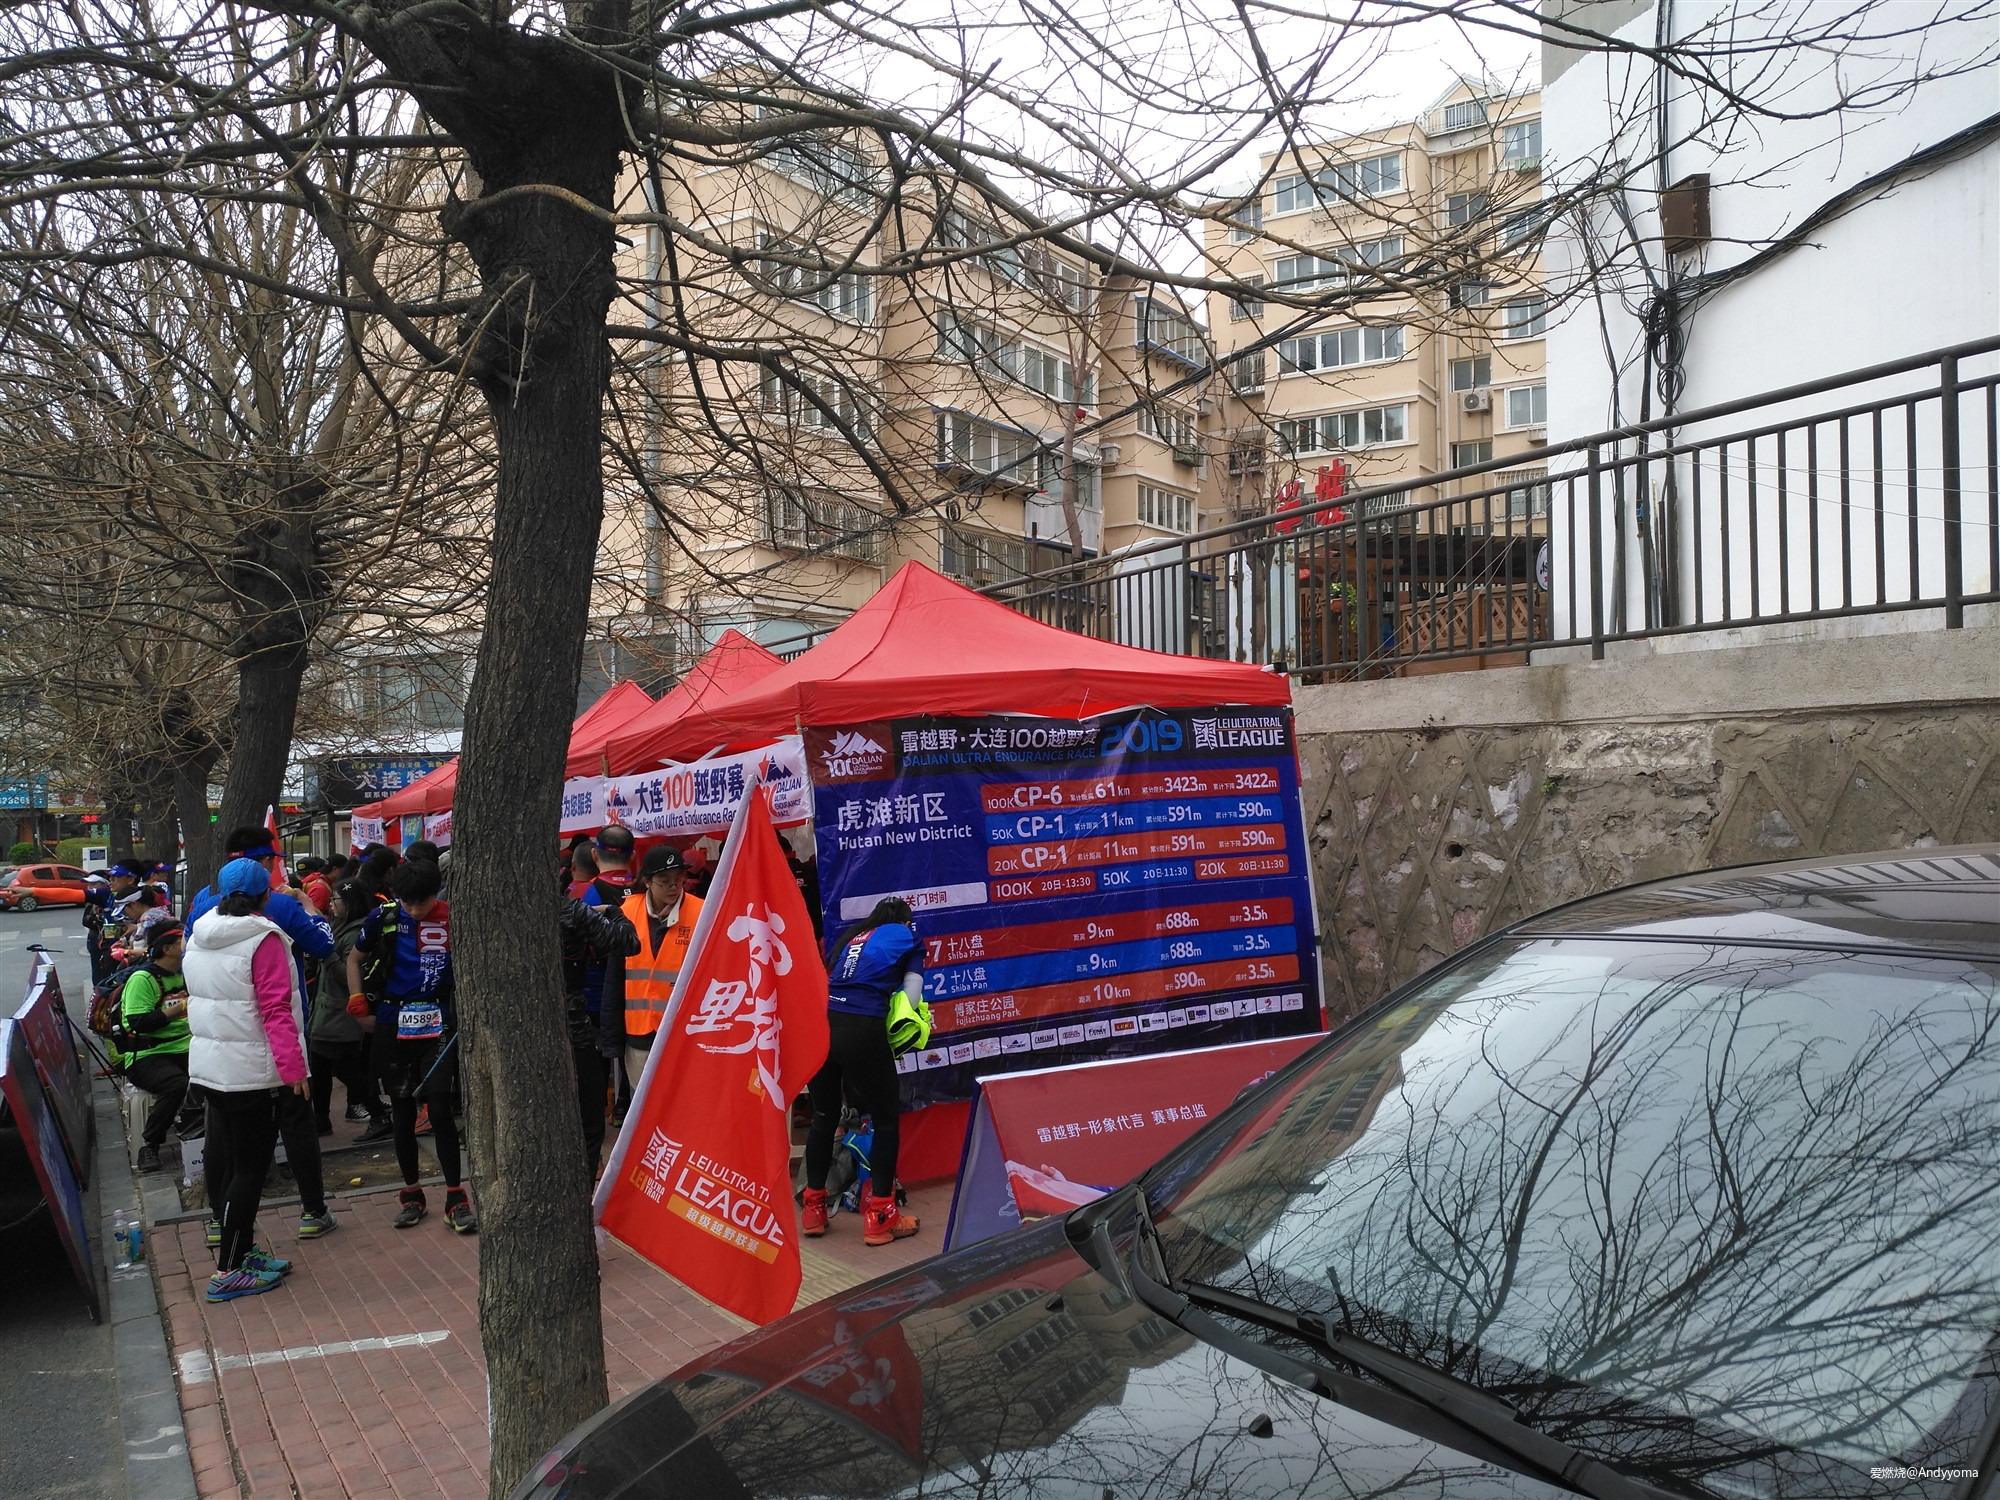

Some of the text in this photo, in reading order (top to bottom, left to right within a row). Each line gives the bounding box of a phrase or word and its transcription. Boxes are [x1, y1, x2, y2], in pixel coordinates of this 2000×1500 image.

[1101, 719, 1183, 757] 2019
[1219, 729, 1285, 747] LEAGUE
[852, 755, 883, 764] DALIAN
[902, 748, 1096, 767] DALIAN ULTRA ENDURANCE RACE
[634, 763, 745, 815] 大连100越野赛
[776, 777, 802, 793] DALIAN
[560, 791, 592, 818] 为您服务
[988, 797, 1015, 809] 100K
[1013, 784, 1063, 807] CP-6
[666, 812, 684, 828] Ultra
[684, 808, 721, 825] Endurance
[837, 792, 948, 832] 虎滩新区
[838, 824, 972, 850] Hutan New District
[992, 828, 1013, 840] 50K
[1016, 814, 1064, 838] CP-1
[994, 859, 1018, 872] 20K
[1021, 844, 1067, 869] CP-1
[1200, 862, 1226, 876] 20K
[996, 880, 1033, 898] 100K
[1103, 870, 1131, 886] 50K
[947, 934, 984, 951] 十八盘
[1242, 905, 1268, 922] 3.5h
[948, 949, 985, 961] Shiba Pan
[951, 967, 987, 984] 十八盘
[1244, 934, 1270, 950] 3.5h
[1247, 963, 1275, 980] 3.5h
[951, 981, 988, 993] Shiba Pan
[402, 1013, 432, 1024] M589
[956, 1008, 1021, 1026] Fujiazhuang Park
[1036, 1103, 1208, 1143] 雷越野-形象代言 赛事总监
[629, 1165, 647, 1192] LEI
[688, 1150, 712, 1172] LEI
[712, 1163, 756, 1196] ULTRA
[643, 1184, 661, 1204] TRAIL
[647, 1177, 665, 1195] ULTRA
[674, 1167, 784, 1247] LEAGUE
[685, 1207, 760, 1254] 超级越野联赛
